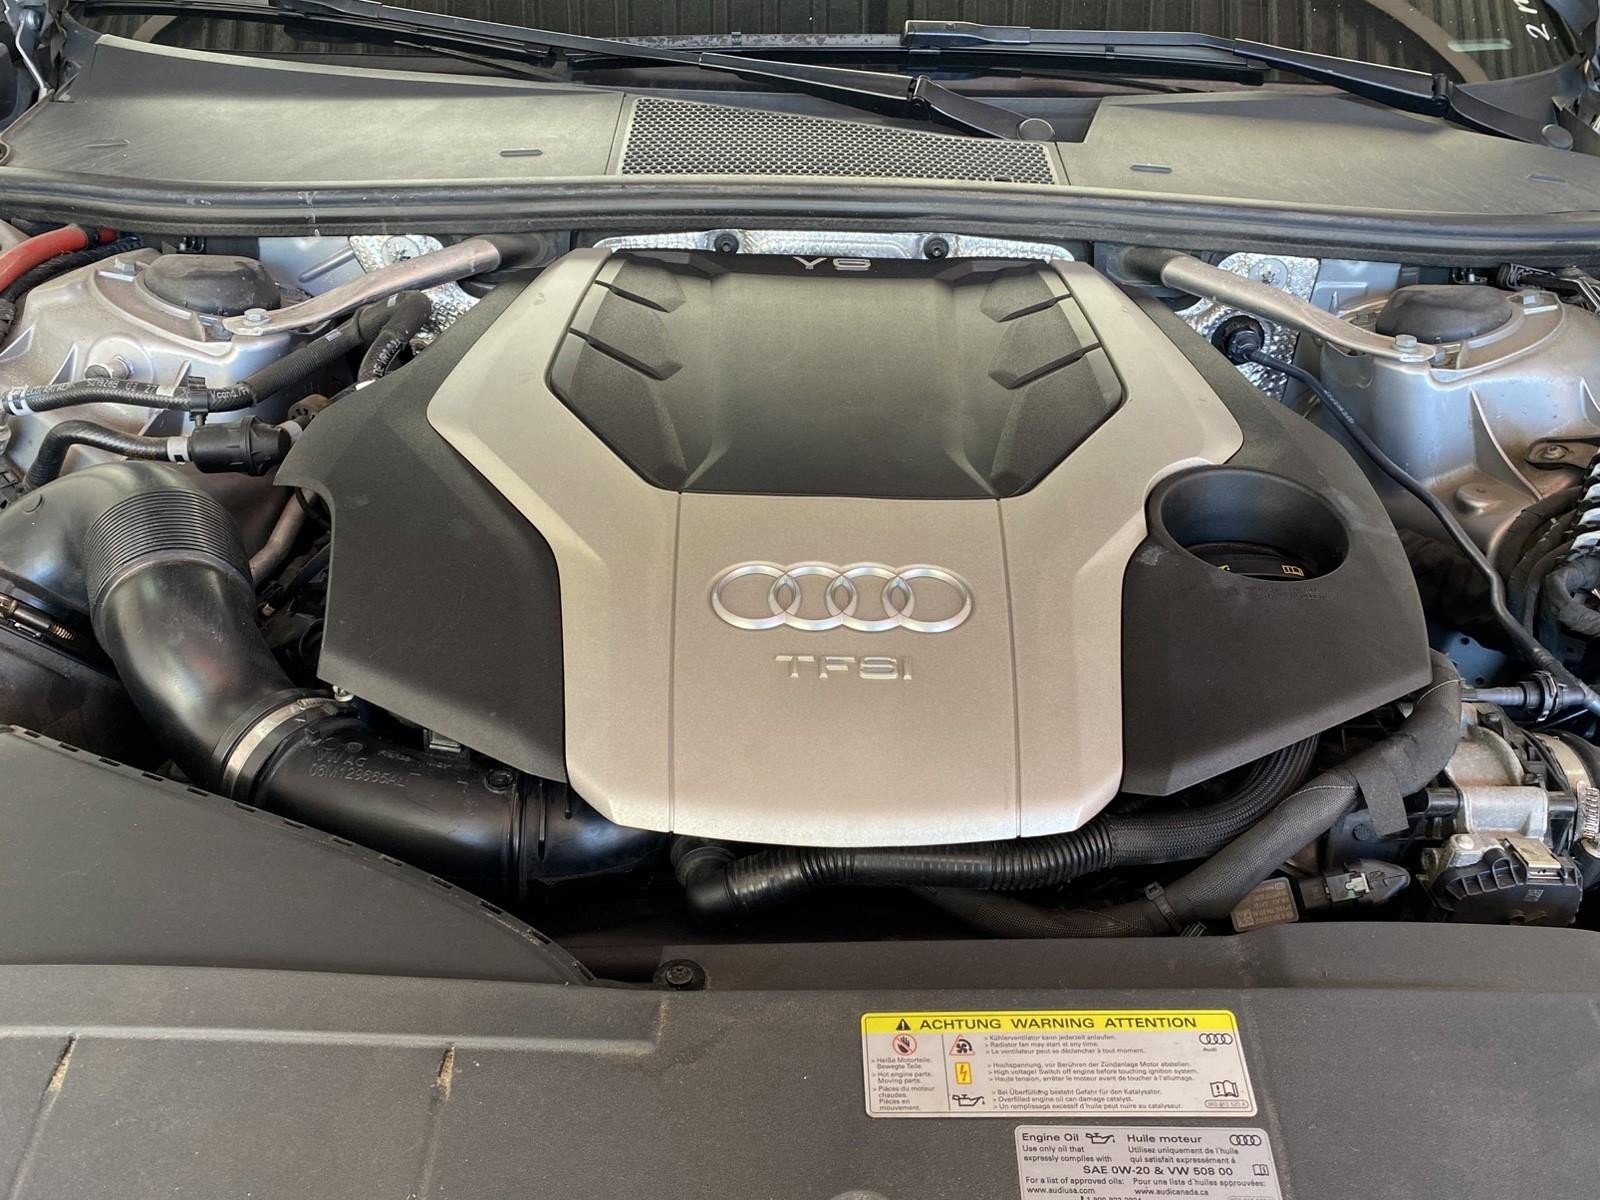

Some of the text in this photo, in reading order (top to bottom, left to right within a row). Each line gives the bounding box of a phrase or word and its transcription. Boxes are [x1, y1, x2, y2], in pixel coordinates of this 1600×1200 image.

[775, 655, 912, 680] TFSI
[920, 1017, 1197, 1030] ACHTUNG WARNING ATTENTION
[1022, 1132, 1079, 1143] Engine Oil
[1126, 1134, 1202, 1143] Huile moteur
[1039, 1145, 1056, 1154] only
[1128, 1146, 1155, 1154] Utilisez
[1157, 1147, 1203, 1155] uniquement
[1023, 1155, 1059, 1163] expressly
[1060, 1155, 1095, 1163] complies
[1130, 1156, 1143, 1164] qui
[1083, 1165, 1233, 1176] SAE 0W-20 & VW 508 00
[1025, 1176, 1038, 1184] For
[1046, 1176, 1059, 1184] list
[1060, 1176, 1068, 1184] of
[1069, 1177, 1106, 1186] approved
[1108, 1177, 1125, 1185] oils:
[1133, 1177, 1151, 1185] Pour
[1169, 1178, 1186, 1186] liste
[1134, 1188, 1209, 1196] www.audicanada.ca
